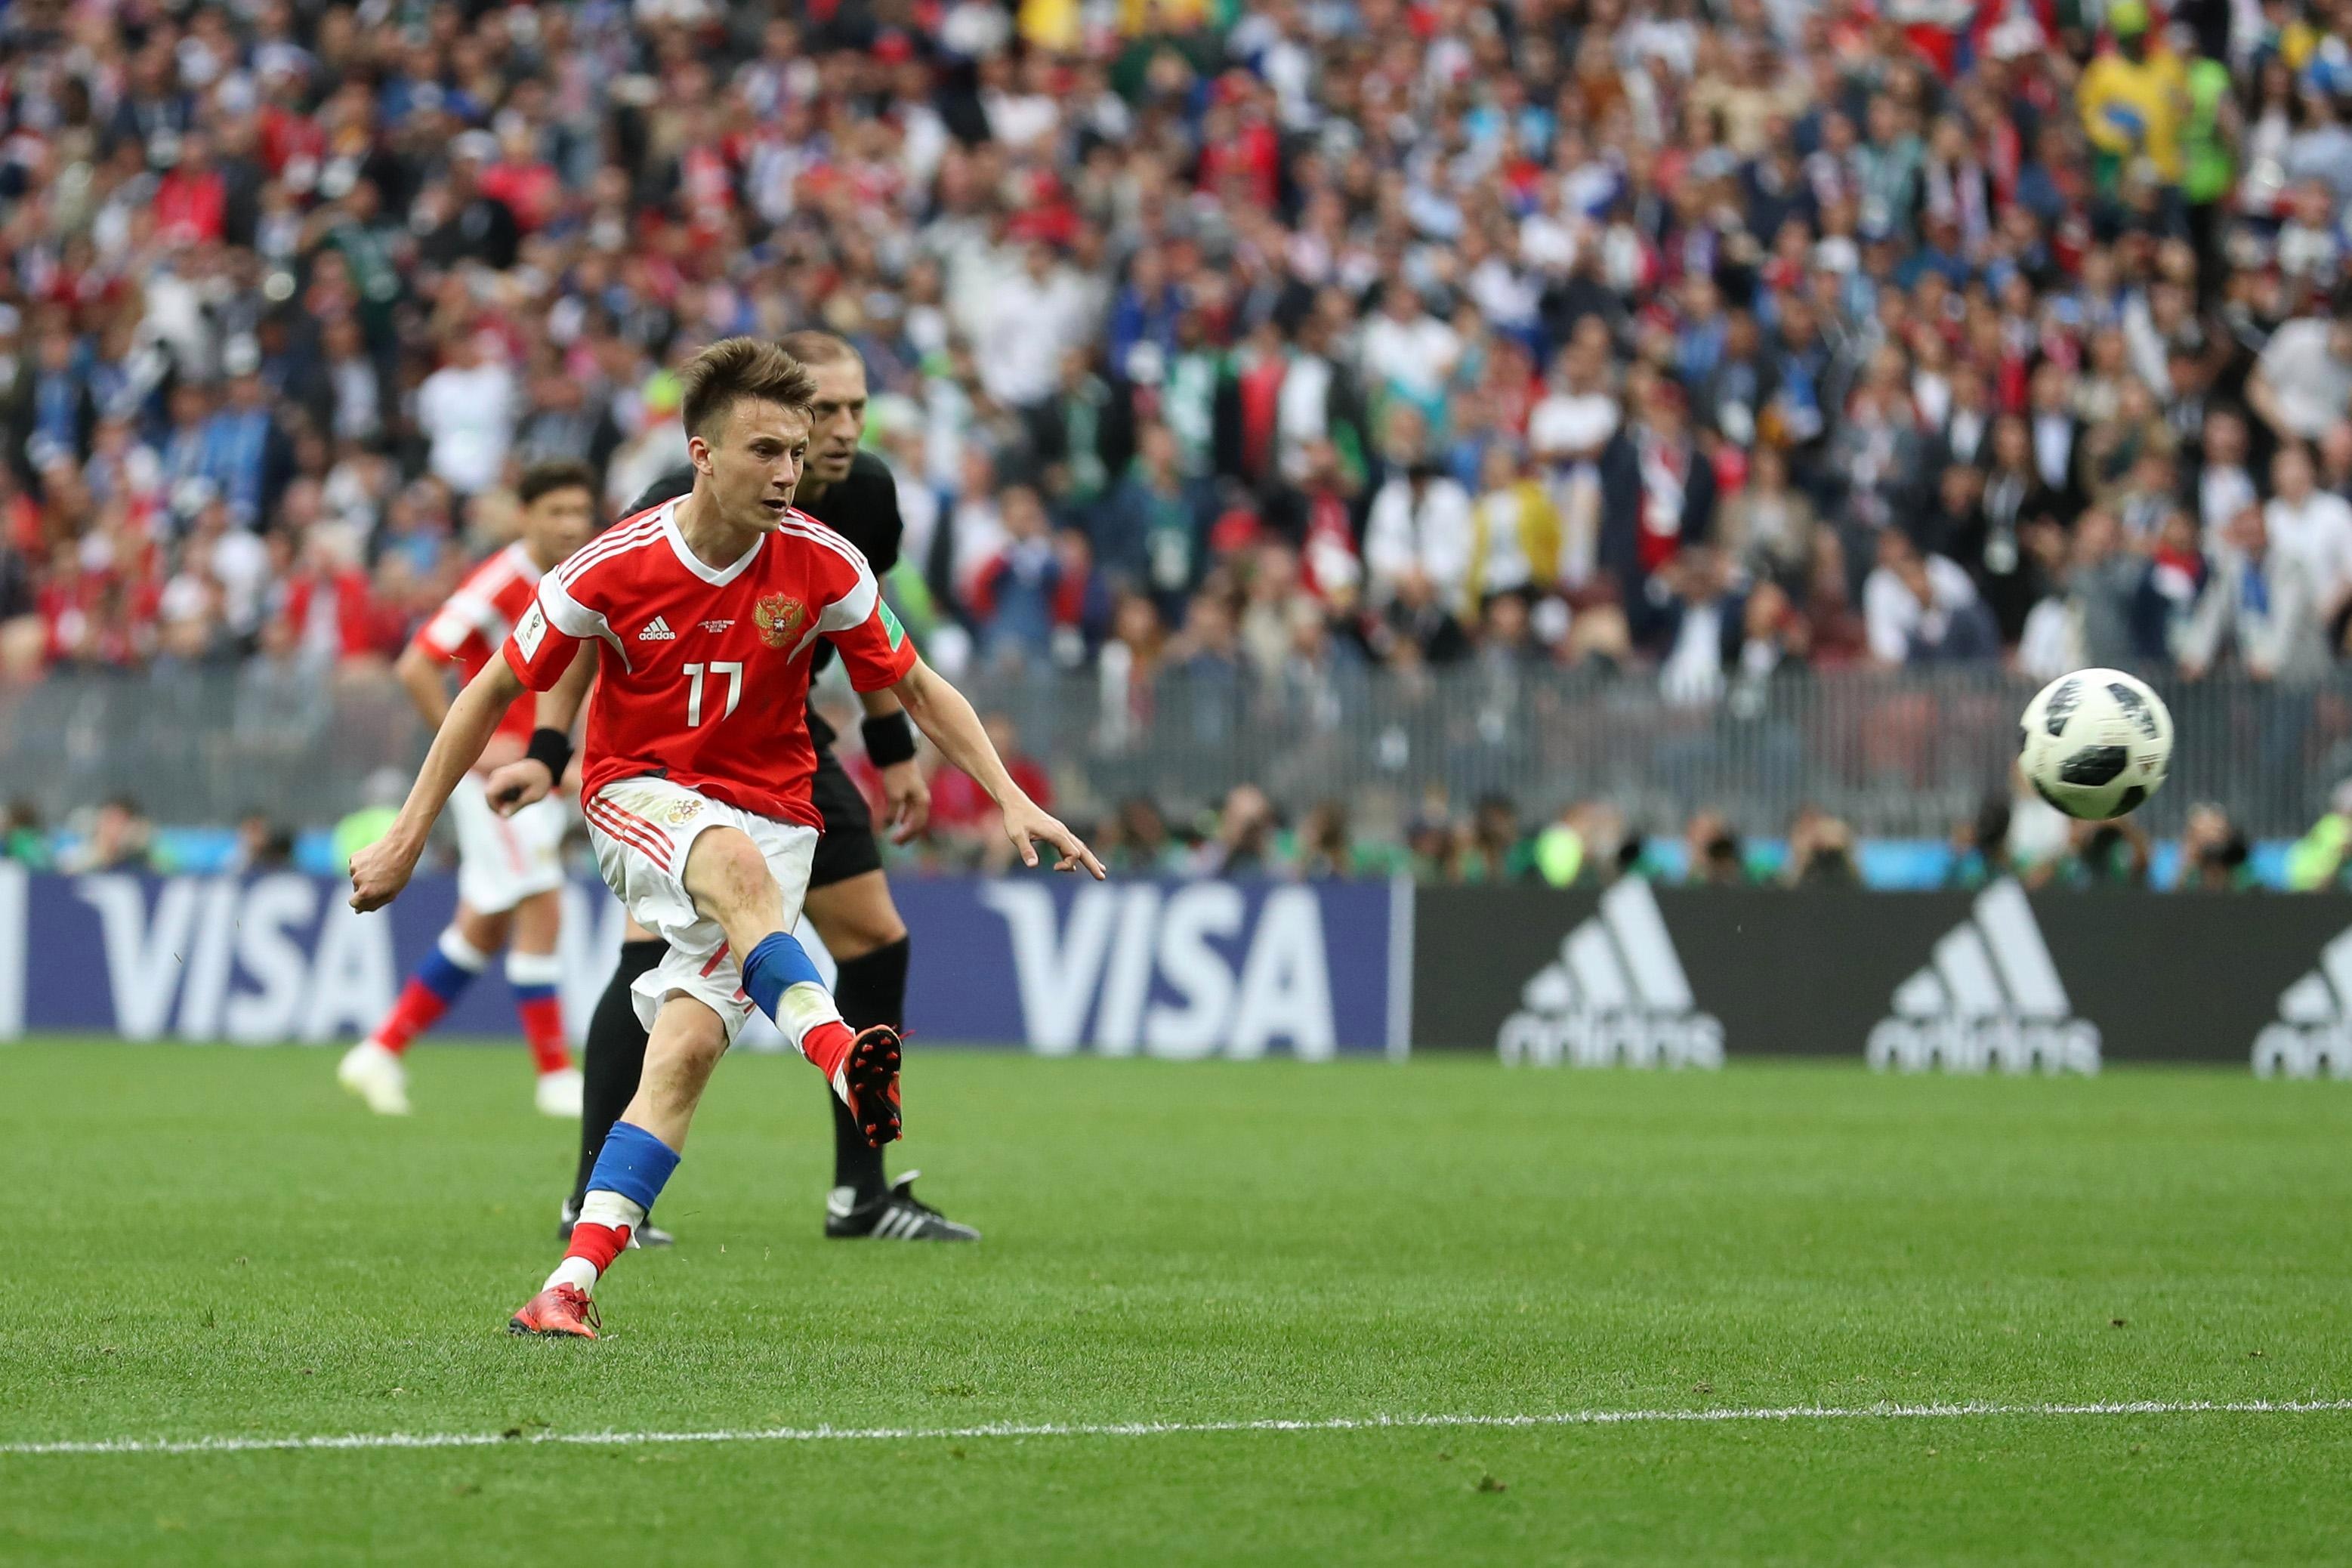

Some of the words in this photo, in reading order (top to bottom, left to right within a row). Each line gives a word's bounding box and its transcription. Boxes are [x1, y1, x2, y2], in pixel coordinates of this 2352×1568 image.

[638, 631, 676, 640] adidas
[683, 661, 742, 727] 17
[76, 873, 397, 1045] VISA
[980, 878, 1337, 1057] VISA
